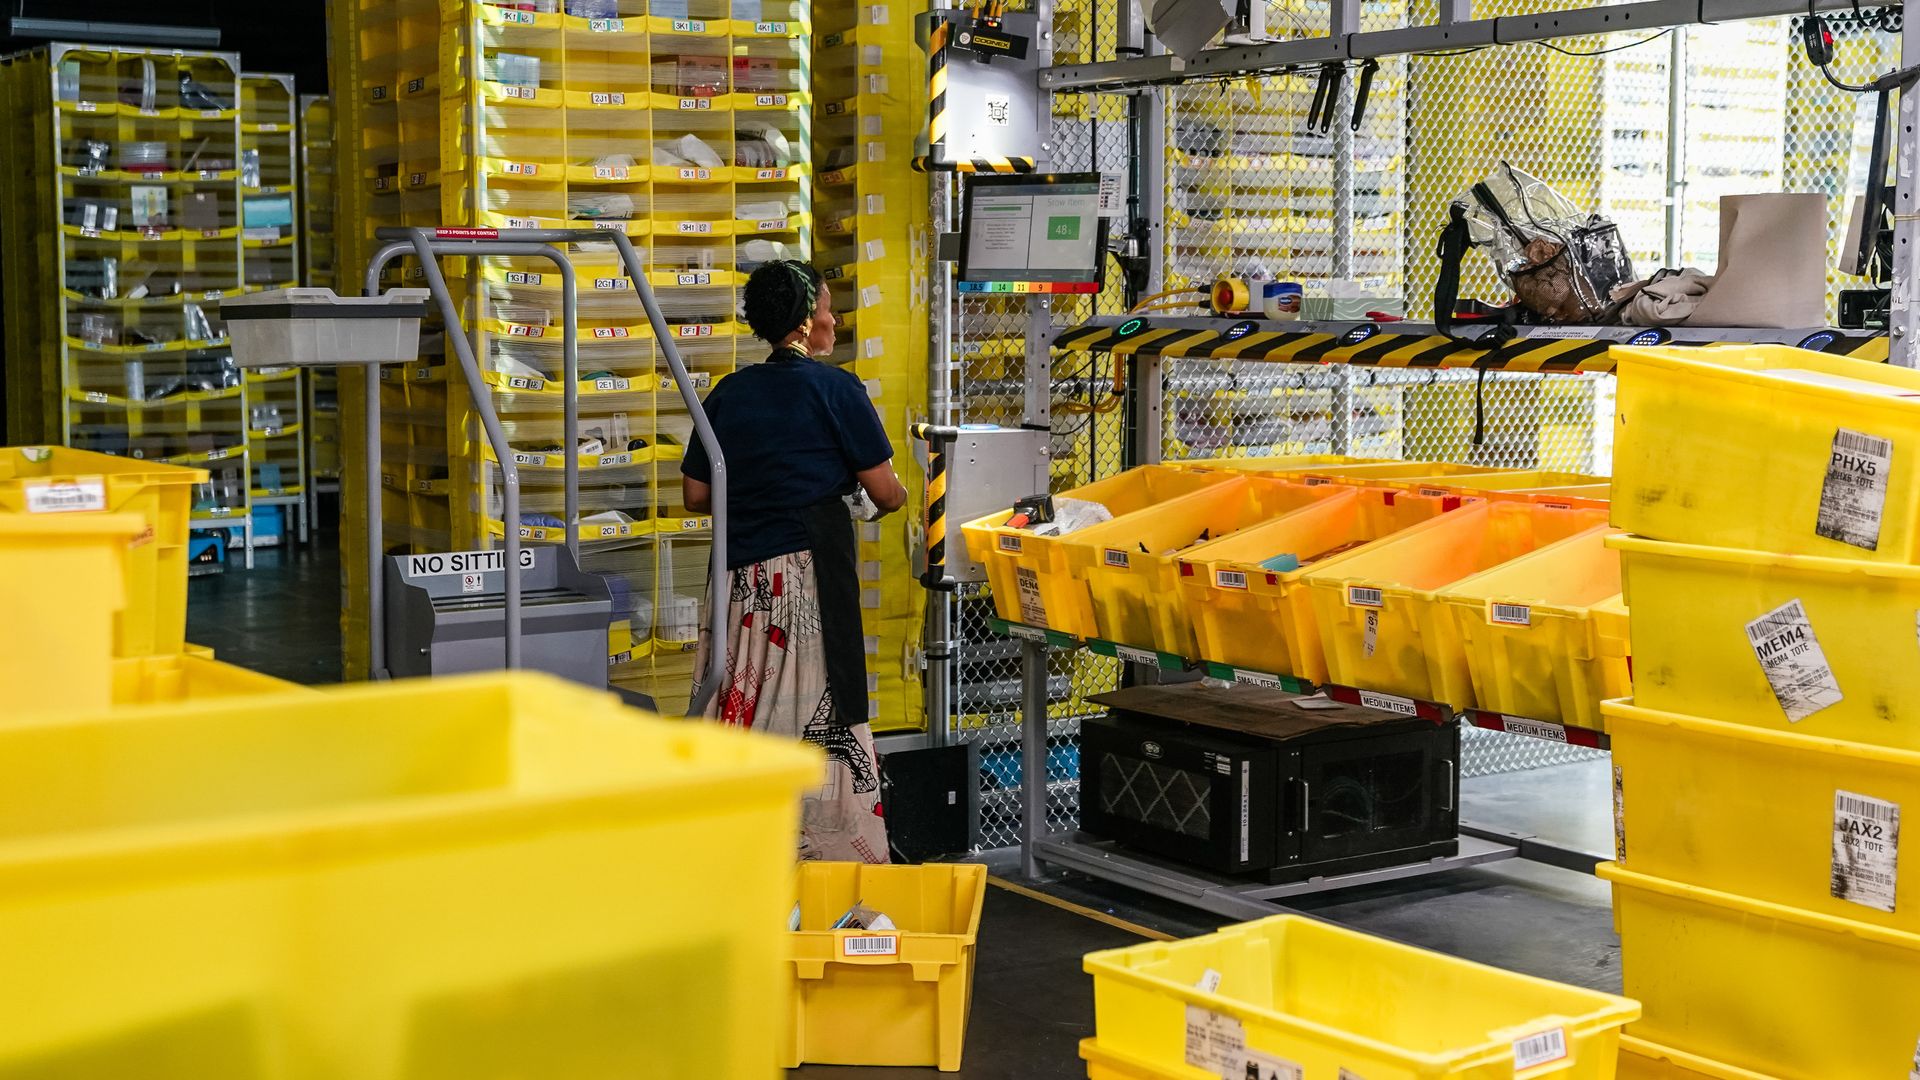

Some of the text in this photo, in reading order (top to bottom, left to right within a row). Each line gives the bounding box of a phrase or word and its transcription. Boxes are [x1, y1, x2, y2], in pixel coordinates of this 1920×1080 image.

[974, 37, 1010, 48] COGNEX
[1831, 452, 1877, 476] PHX5
[1856, 476, 1875, 489] TOTE
[413, 550, 532, 575] NO SITTIG
[1756, 626, 1805, 660] MEM4
[1118, 651, 1159, 665] SMALL ITEMS
[1767, 642, 1810, 669] MEM4 TOTE
[1237, 675, 1281, 690] SMALL ITEMS
[1363, 697, 1416, 715] MEDIUM ITEMS
[1506, 722, 1565, 741] MEDIUM ITEMS
[1840, 817, 1883, 840] JAX2
[1841, 833, 1884, 853] JAX2 TOTE
